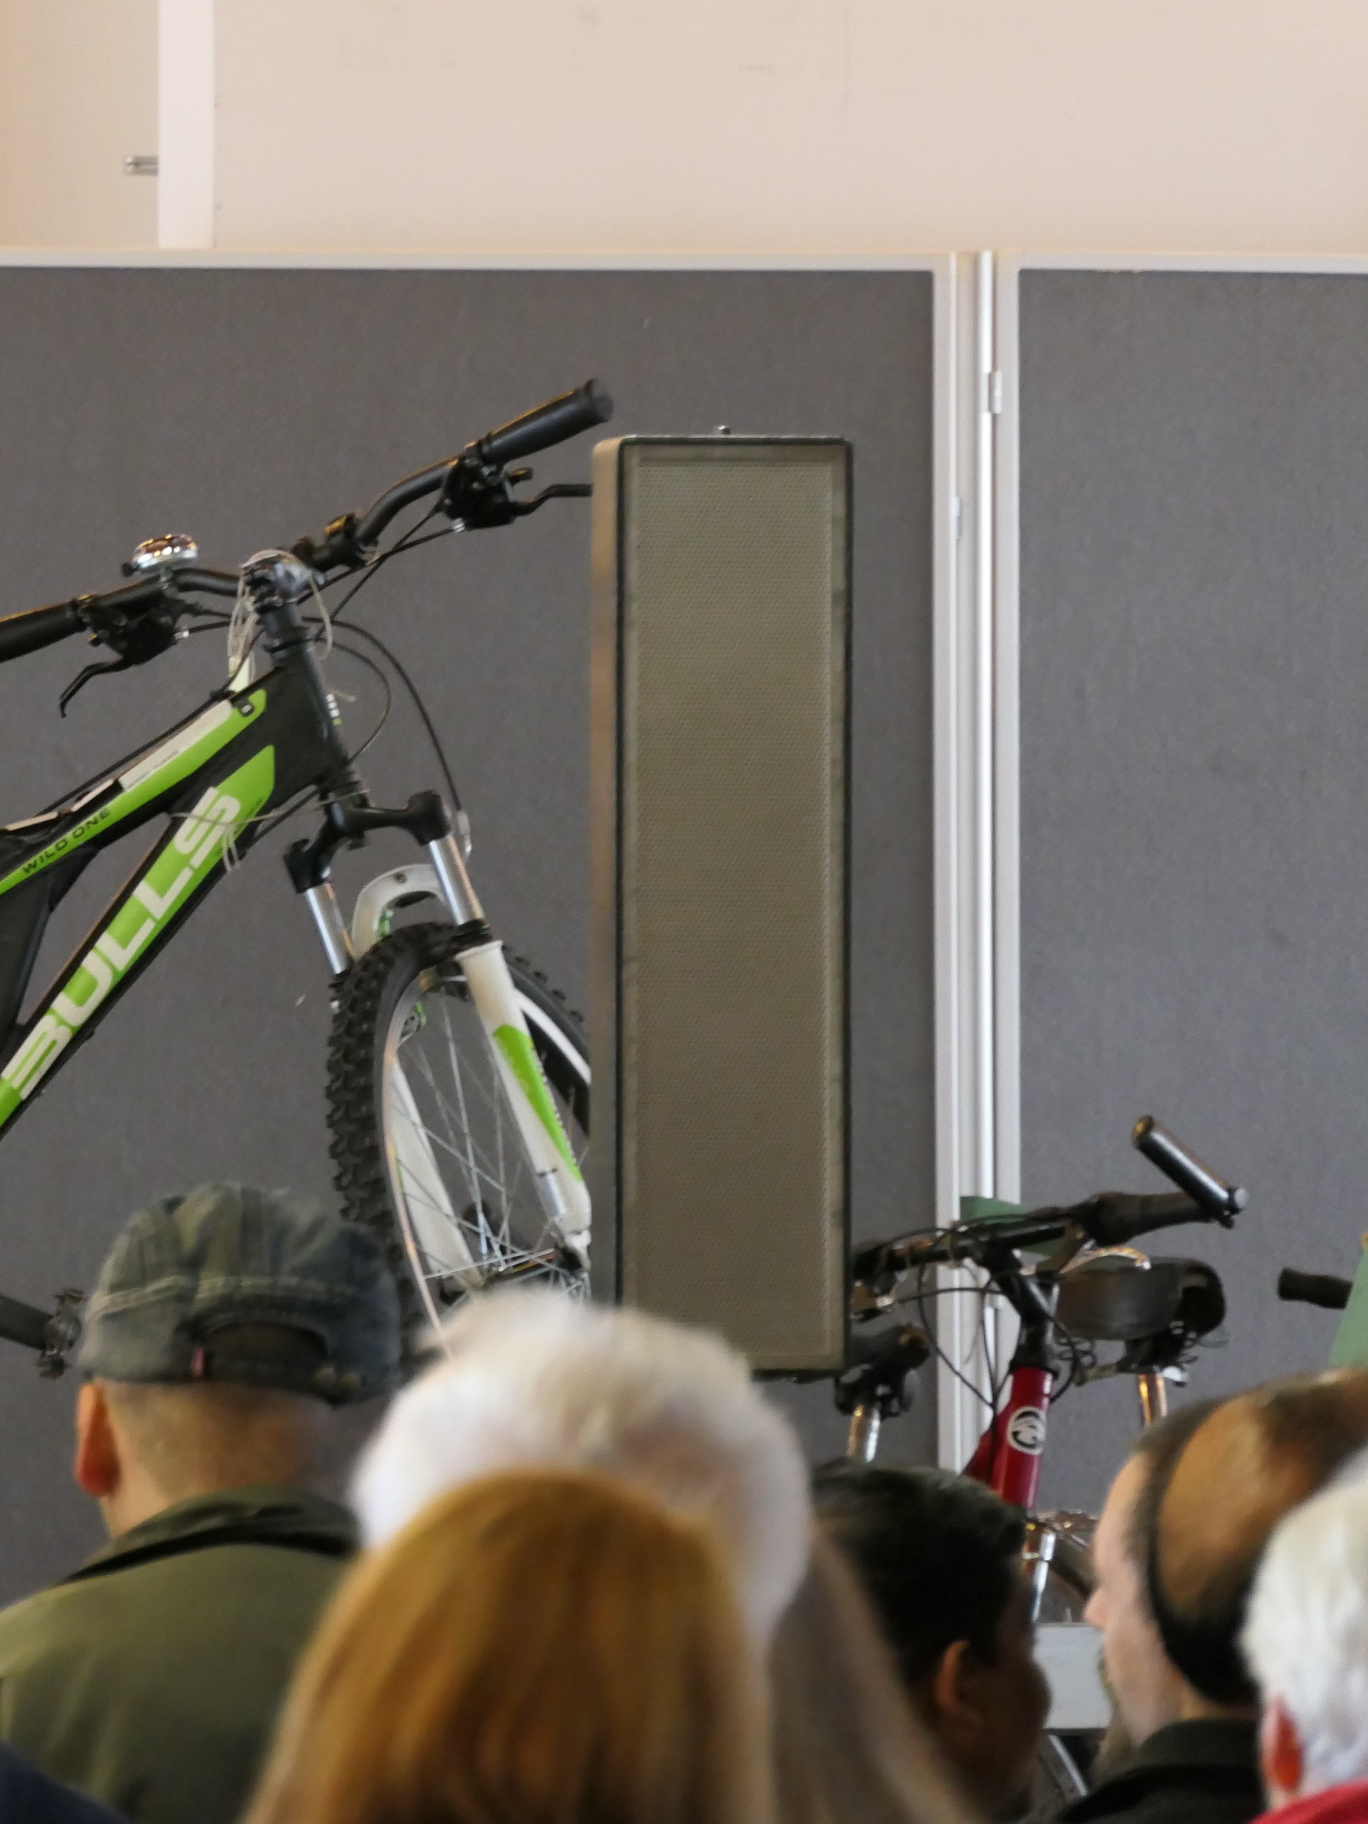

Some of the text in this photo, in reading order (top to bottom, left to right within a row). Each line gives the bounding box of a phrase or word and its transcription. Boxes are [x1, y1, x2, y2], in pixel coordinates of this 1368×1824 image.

[22, 807, 110, 874] WILD ONE
[1, 786, 241, 1100] BULLS
